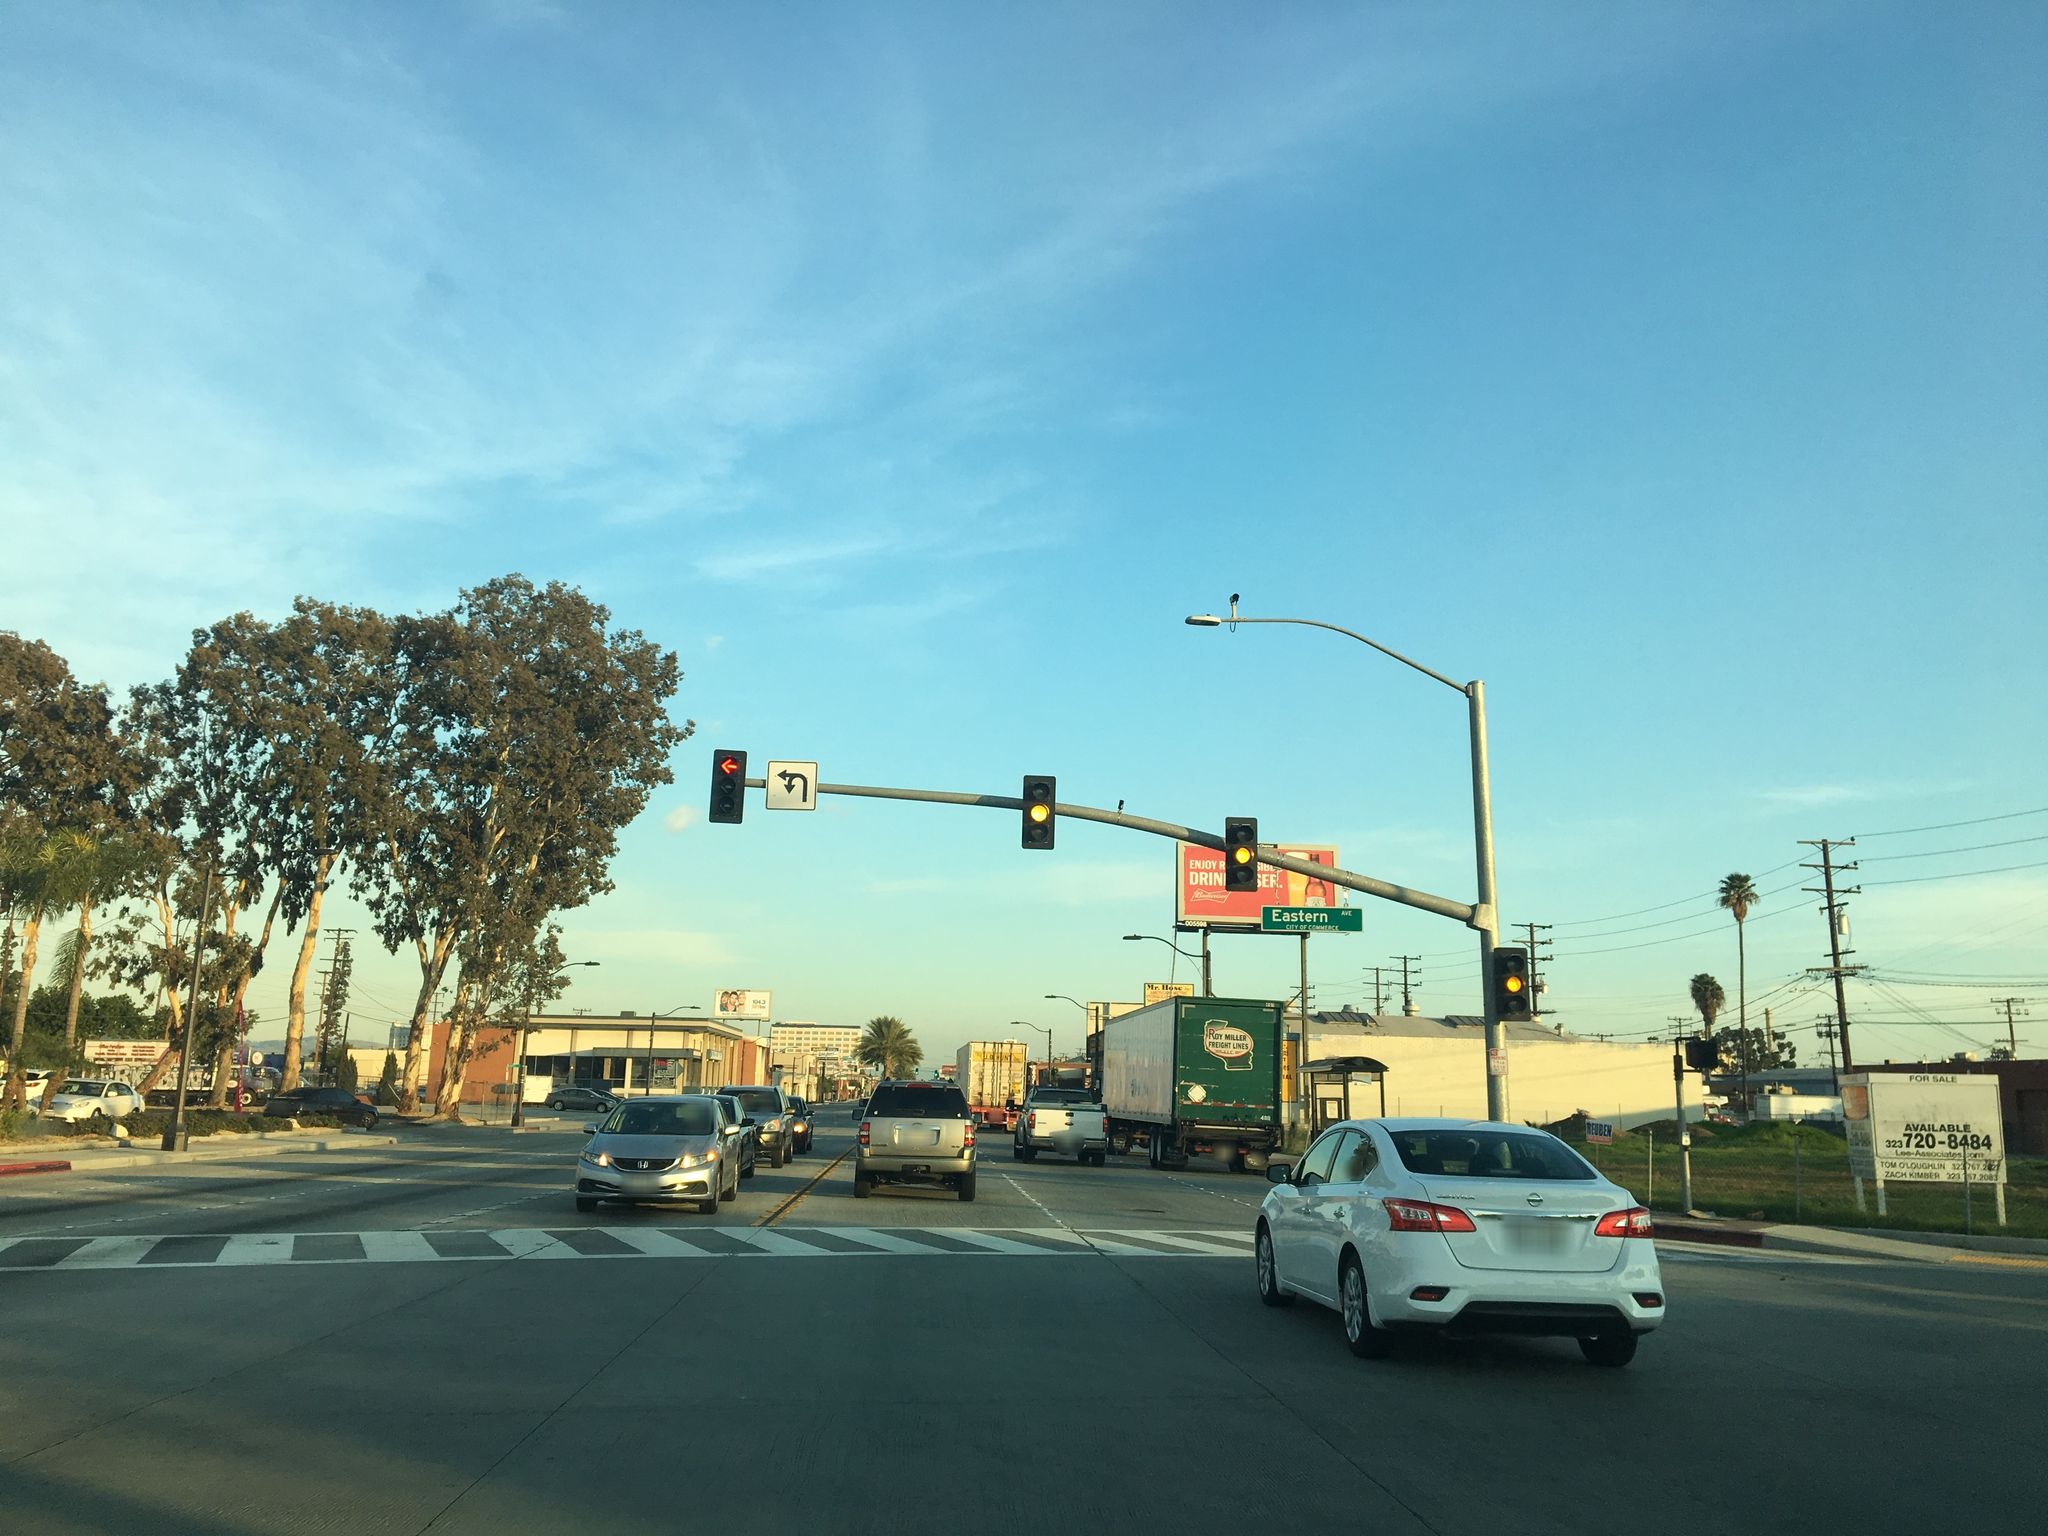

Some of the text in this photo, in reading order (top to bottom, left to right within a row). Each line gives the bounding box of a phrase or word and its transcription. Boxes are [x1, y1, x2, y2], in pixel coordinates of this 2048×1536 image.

[1190, 860, 1217, 870] ENJOY
[1190, 871, 1227, 886] DRIN
[1272, 909, 1328, 922] Eastern
[1208, 1041, 1249, 1050] FREIGHT LINES
[1932, 1075, 1957, 1083] SALE
[1587, 1122, 1612, 1137] REUBEN
[1904, 1123, 1971, 1133] AVAILABLE
[1885, 1133, 1992, 1150] 323 720-8484
[1895, 1150, 1985, 1159] Lee-Associatescom
[1881, 1161, 1897, 1169] TOM
[1884, 1171, 1907, 1179] ZACH
[1909, 1171, 1940, 1180] KIMBER
